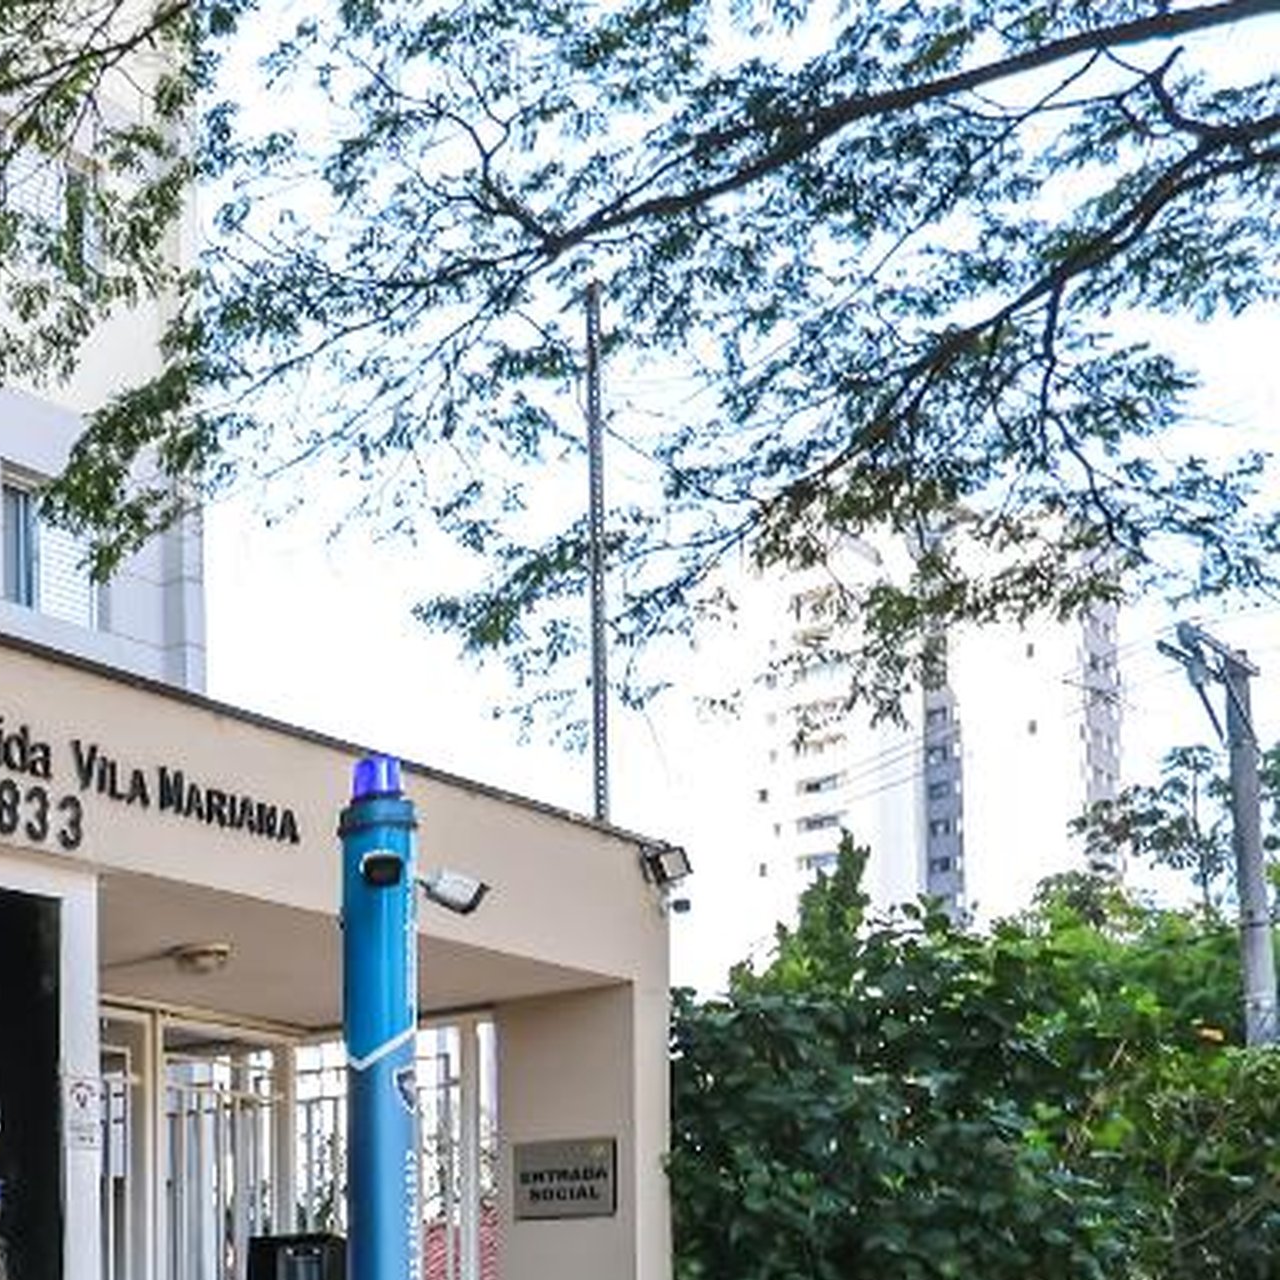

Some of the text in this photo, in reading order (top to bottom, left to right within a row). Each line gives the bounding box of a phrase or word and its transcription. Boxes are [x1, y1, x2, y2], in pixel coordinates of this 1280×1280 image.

[71, 739, 148, 809] VILA
[159, 766, 301, 845] MARIANA
[519, 1165, 609, 1185] ENTRADA
[528, 1185, 601, 1202] SOCIAL
